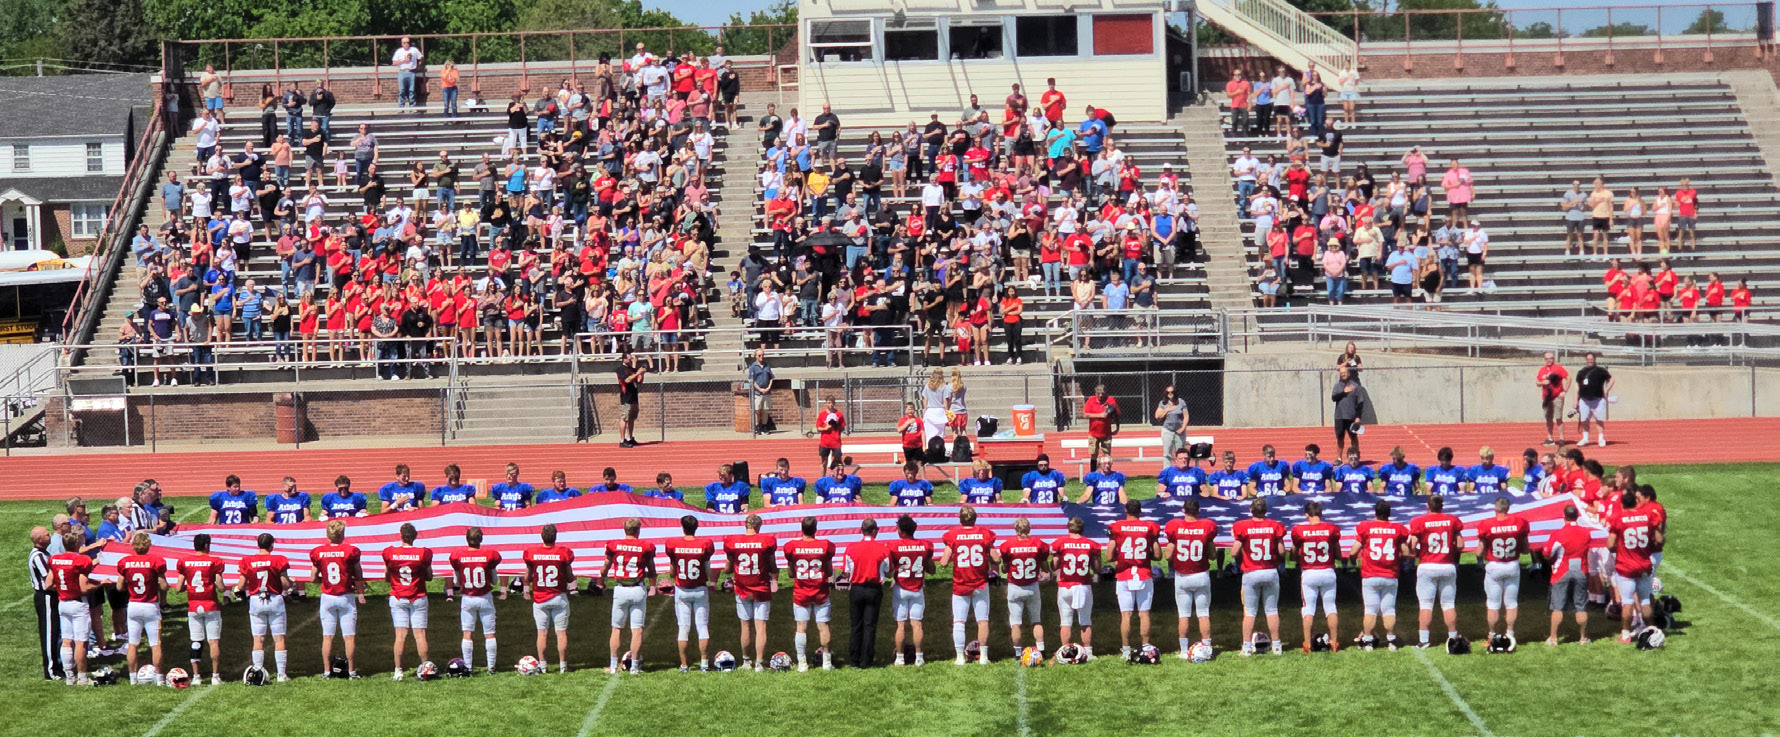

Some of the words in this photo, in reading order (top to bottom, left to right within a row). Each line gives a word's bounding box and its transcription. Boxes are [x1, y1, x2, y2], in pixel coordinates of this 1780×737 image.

[1037, 491, 1054, 504] 23
[1101, 491, 1116, 505] 20
[226, 511, 242, 524] 73
[719, 504, 734, 513] 54
[1063, 542, 1091, 550] MILLER
[1121, 537, 1147, 559] 42
[1428, 532, 1449, 553] 61
[1624, 526, 1648, 549] 65
[957, 545, 983, 567] 26
[1010, 546, 1038, 554] FRENCH
[1177, 540, 1203, 561] 50
[1250, 539, 1271, 560] 51
[1304, 542, 1329, 563] 53
[1370, 538, 1395, 560] 54
[1492, 538, 1517, 559] 62
[327, 562, 340, 584] 8
[615, 556, 638, 578] 14
[678, 559, 700, 579] 16
[738, 554, 760, 574] 21
[796, 560, 822, 579] 22
[898, 556, 923, 577] 24
[1011, 558, 1036, 579] 32
[1063, 554, 1089, 575] 33
[132, 573, 145, 594] 3
[192, 571, 204, 592] 4
[257, 571, 268, 594] 7
[399, 566, 412, 585] 9
[464, 567, 485, 588] 10
[536, 566, 558, 587] 12
